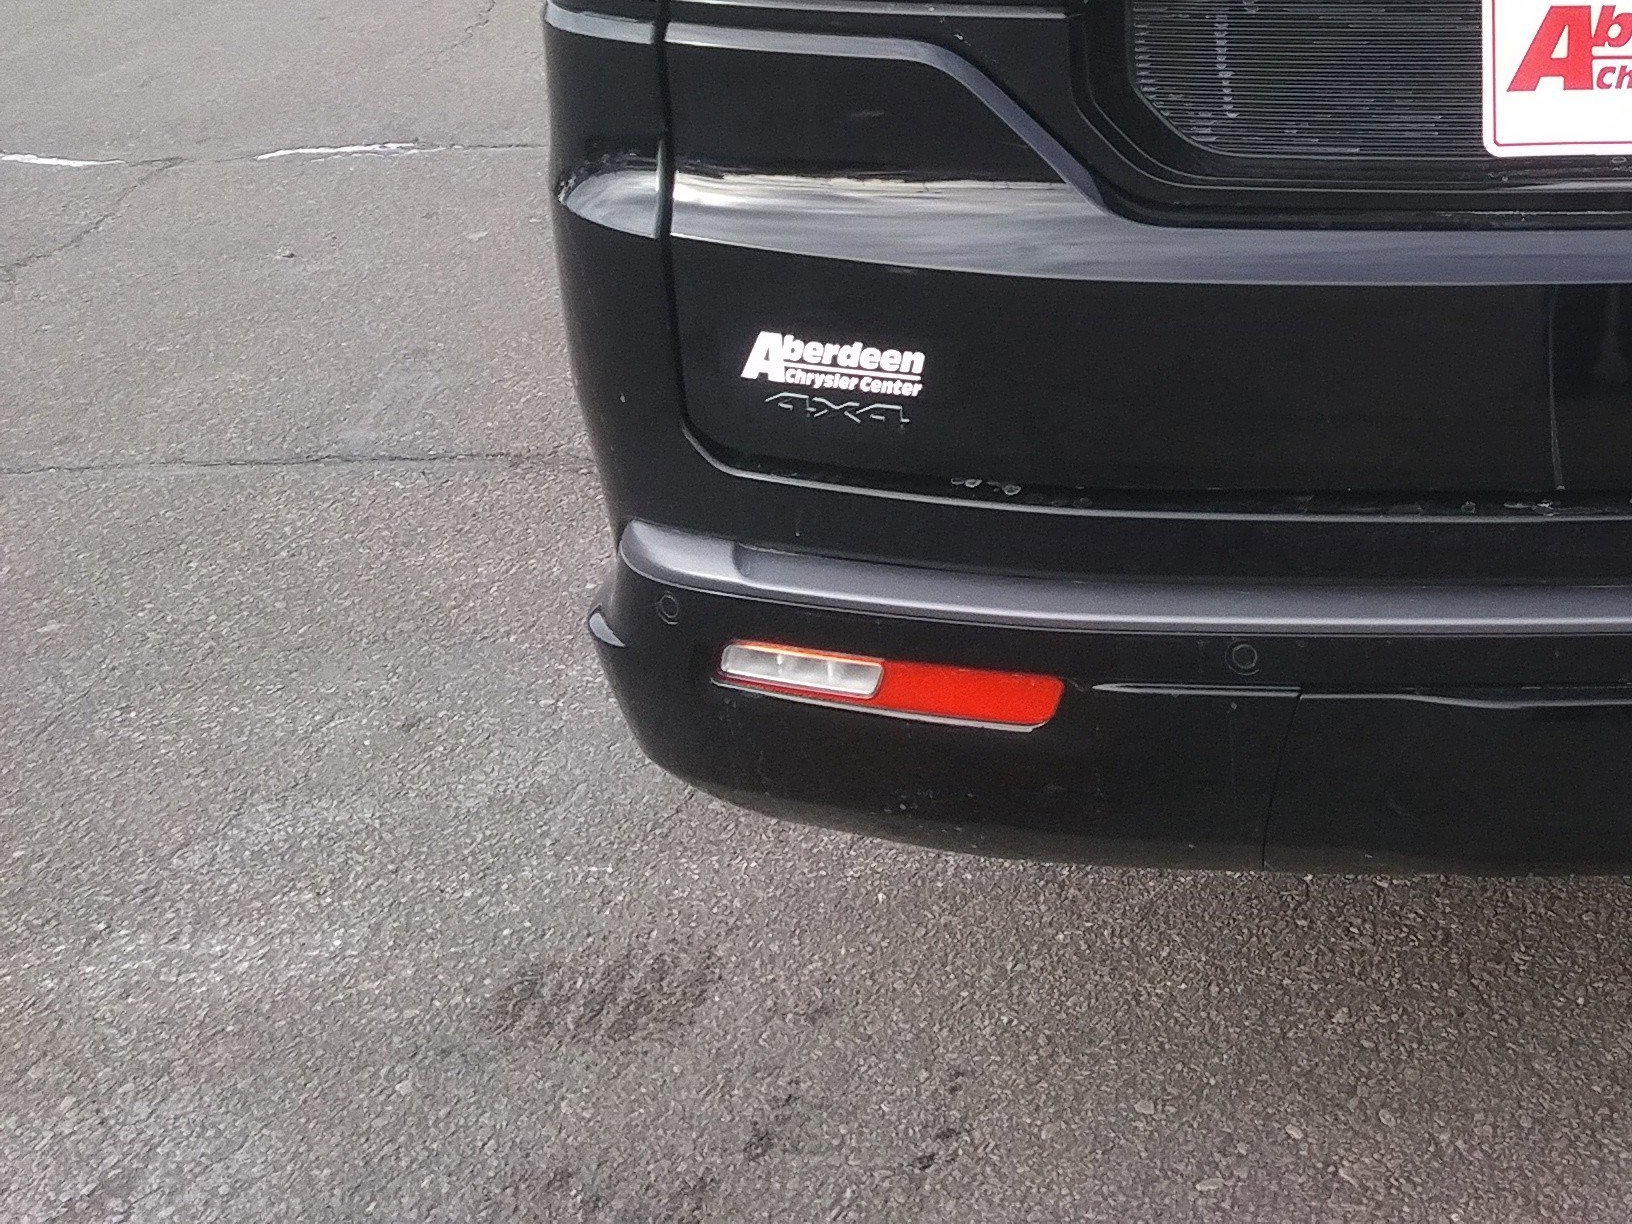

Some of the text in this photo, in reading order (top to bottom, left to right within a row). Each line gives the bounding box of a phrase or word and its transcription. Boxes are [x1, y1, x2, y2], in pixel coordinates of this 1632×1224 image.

[740, 331, 926, 383] Aberdeen
[785, 368, 923, 398] Chrysler Center
